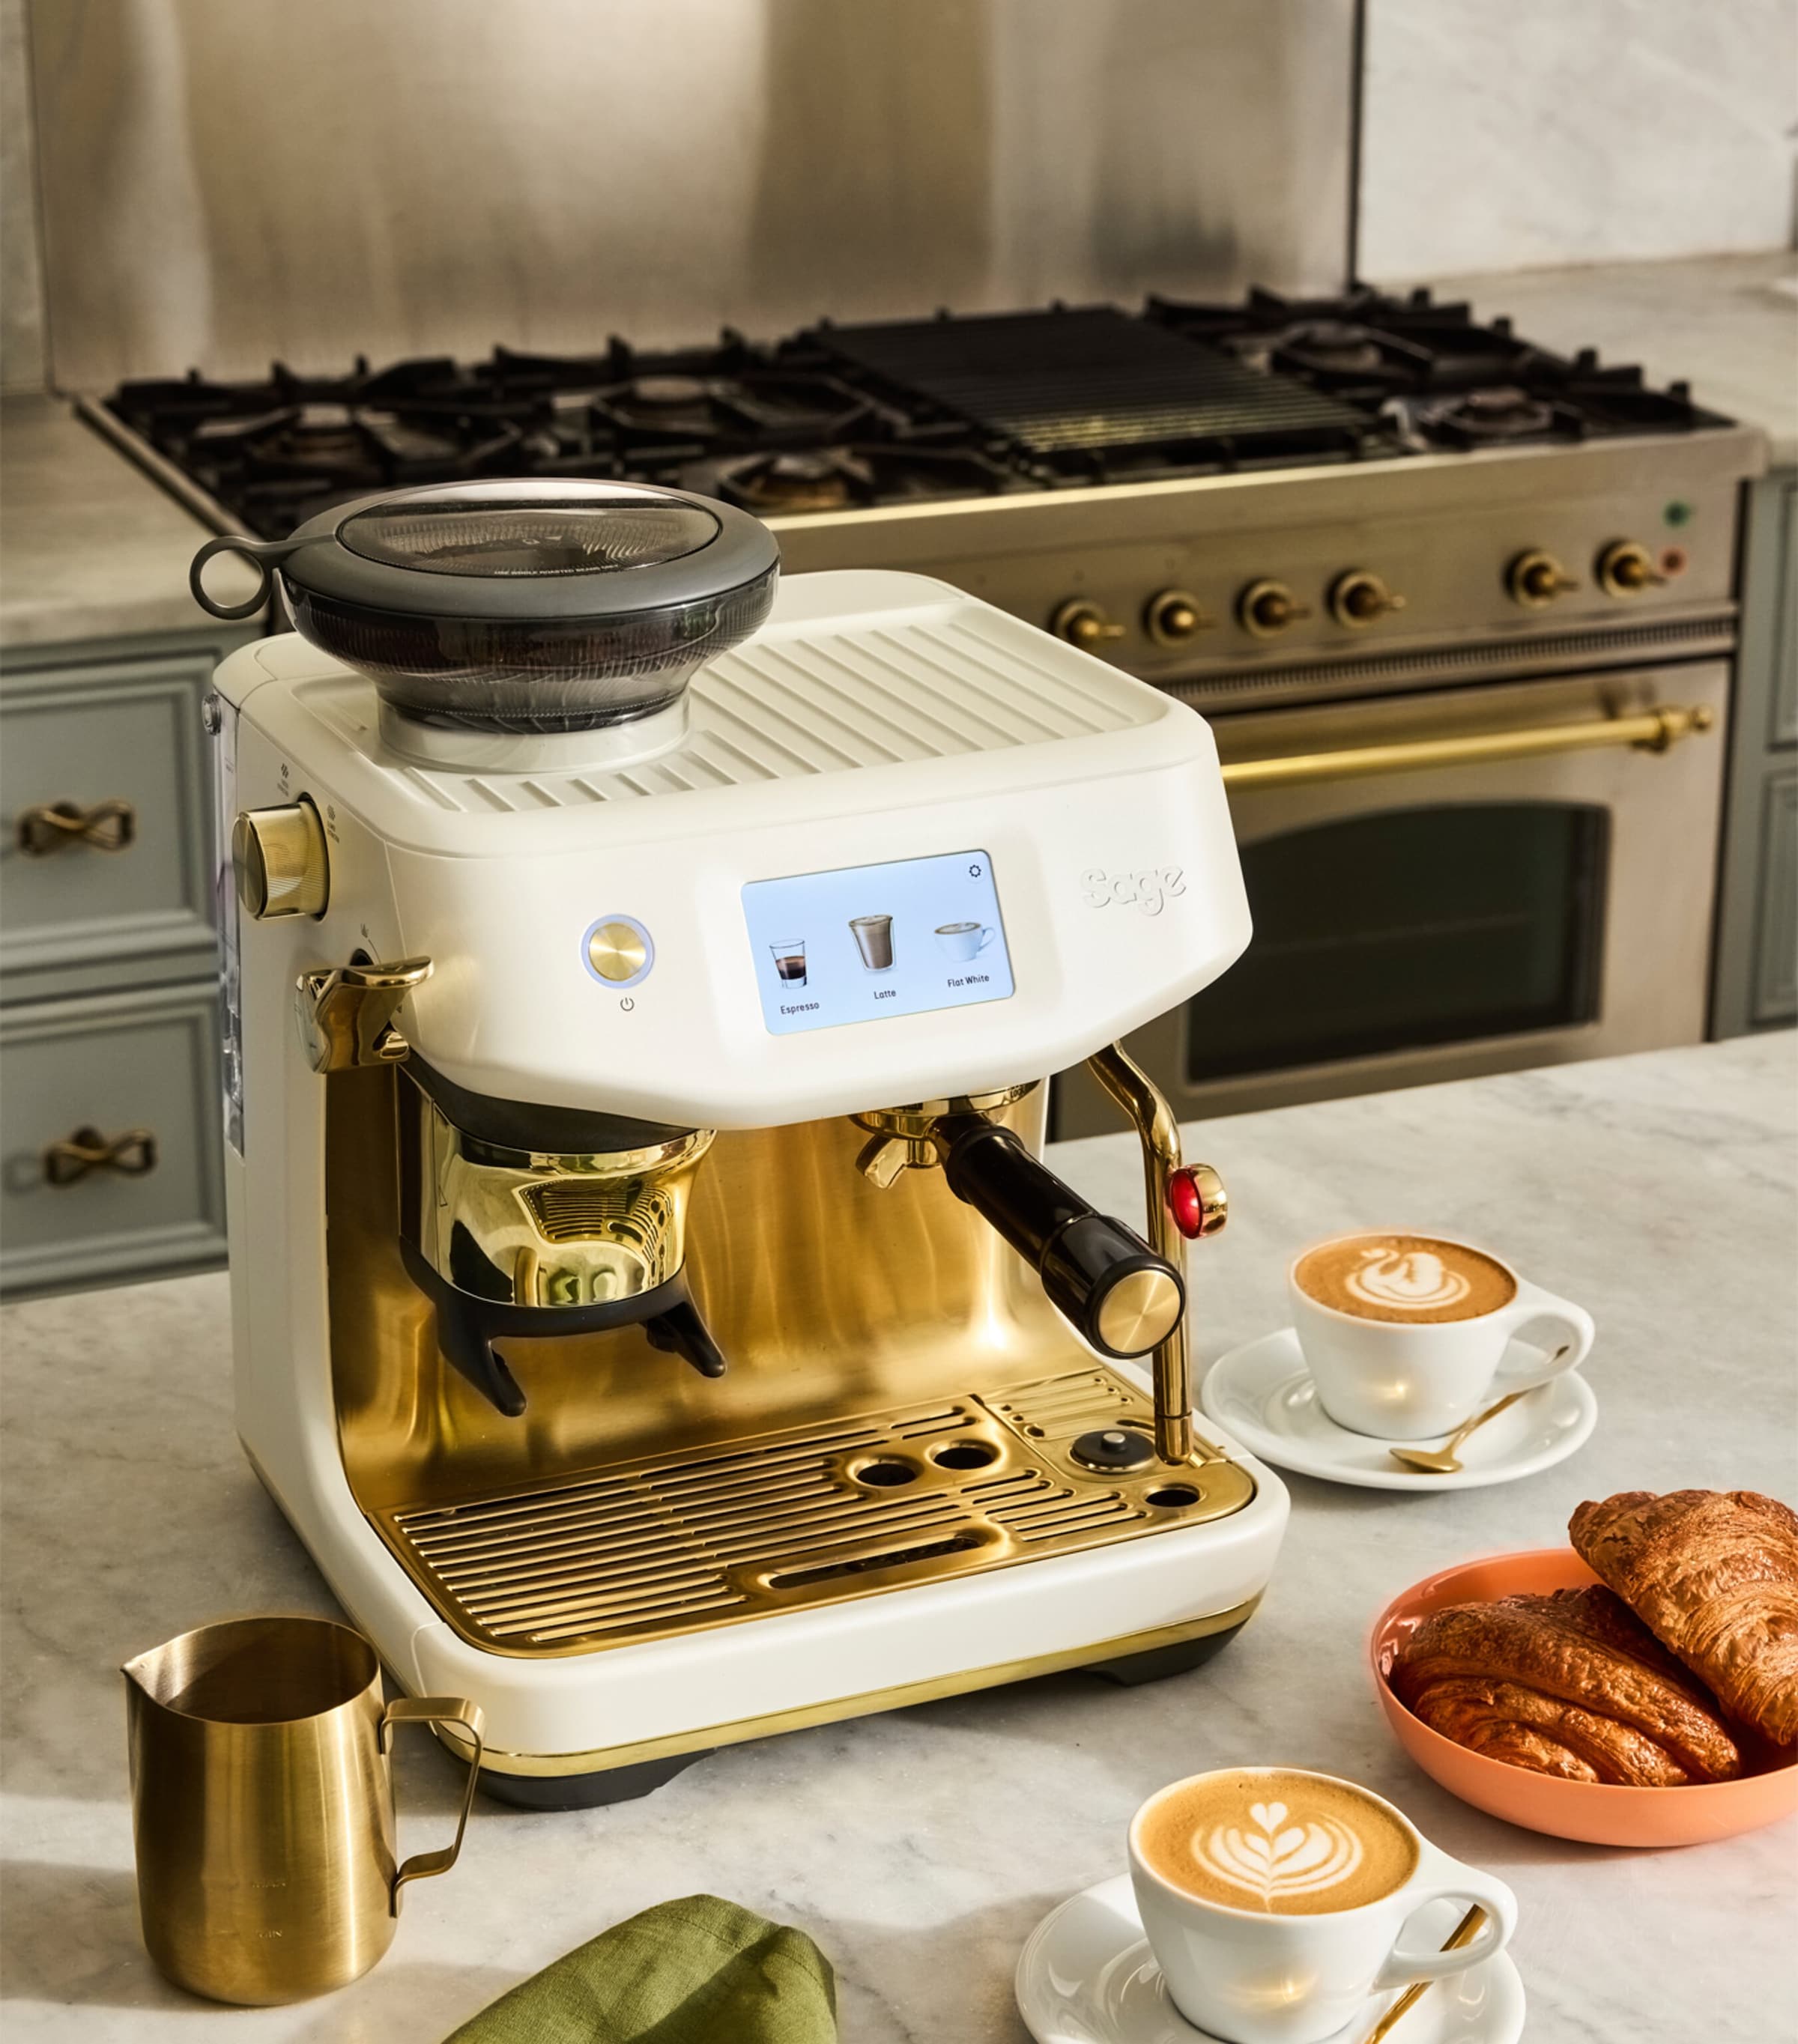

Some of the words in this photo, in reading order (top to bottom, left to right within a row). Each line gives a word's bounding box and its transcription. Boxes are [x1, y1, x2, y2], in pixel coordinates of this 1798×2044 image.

[1081, 866, 1187, 917] Sage
[947, 978, 964, 988] Flat
[964, 974, 990, 984] White
[874, 989, 896, 1000] Latte
[780, 1002, 820, 1016] Espresso
